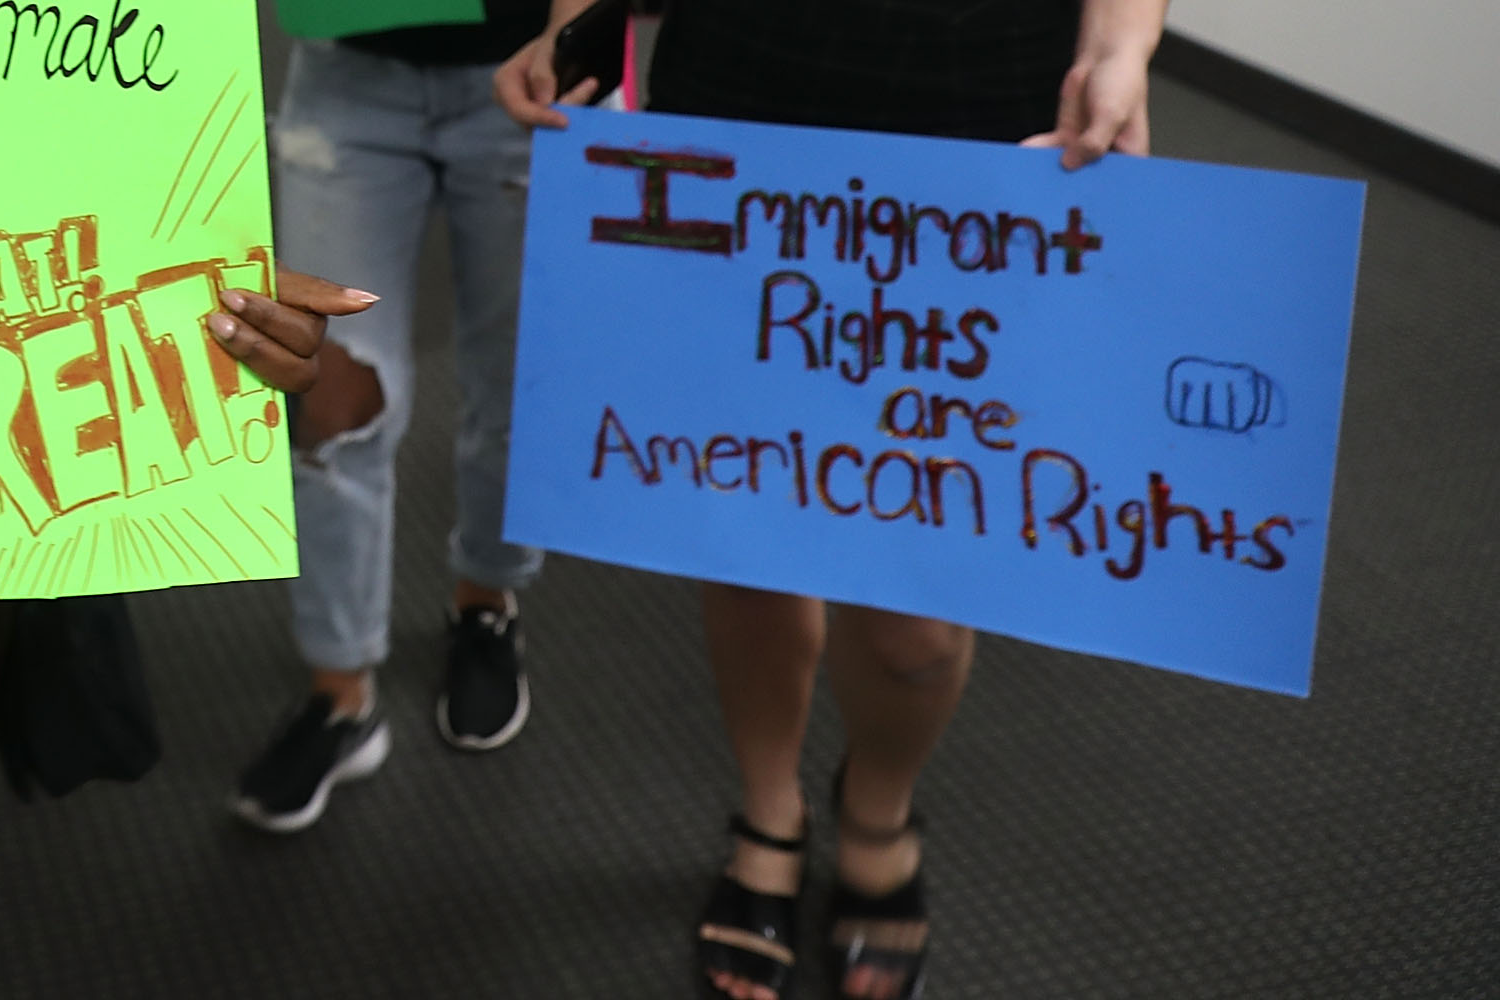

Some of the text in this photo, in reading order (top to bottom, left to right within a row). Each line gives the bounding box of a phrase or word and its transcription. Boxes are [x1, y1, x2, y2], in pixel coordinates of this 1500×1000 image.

[585, 145, 1102, 282] Immigrant
[756, 271, 999, 383] Rights
[880, 386, 1019, 450] are
[591, 406, 1298, 580] American Rights
